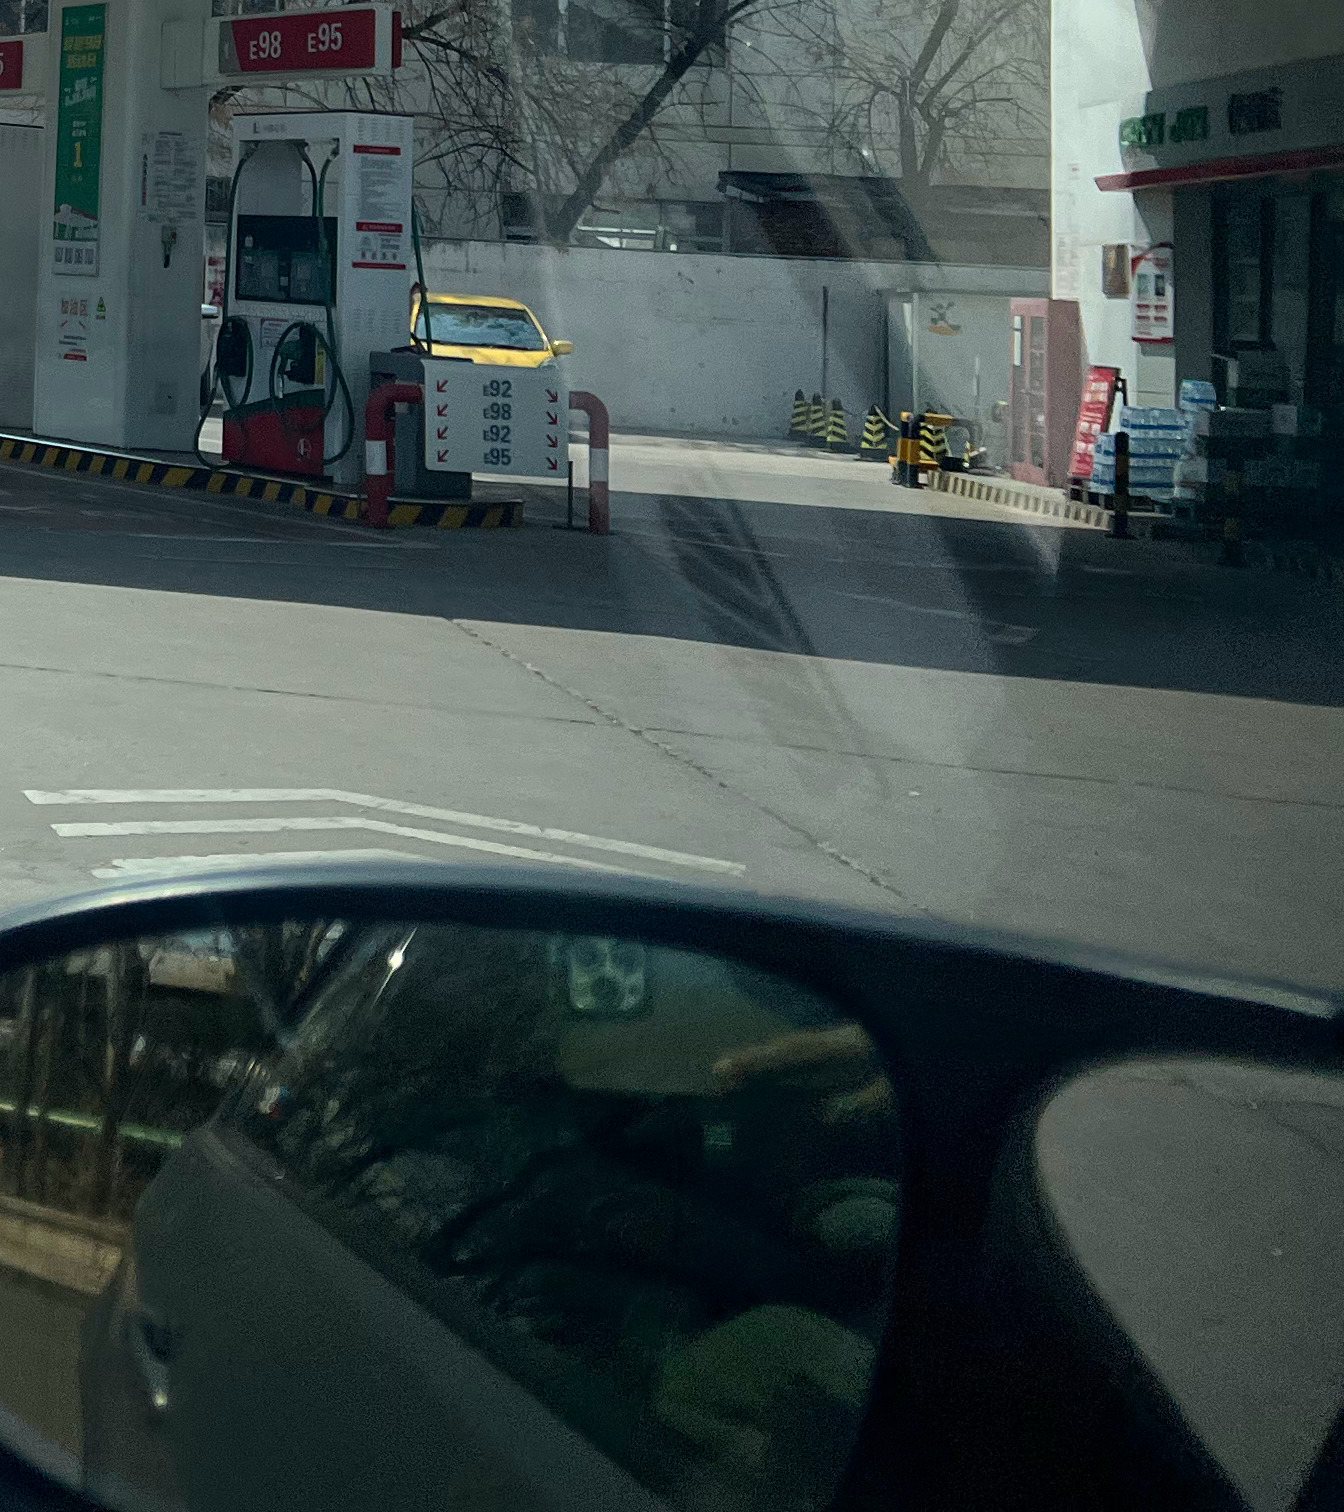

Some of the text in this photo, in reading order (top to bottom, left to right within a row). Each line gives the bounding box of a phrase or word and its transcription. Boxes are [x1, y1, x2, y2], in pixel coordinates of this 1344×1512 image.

[249, 23, 343, 60] E98 E95
[483, 380, 512, 398] E92
[483, 403, 512, 421] E98
[483, 425, 511, 443] E92
[483, 448, 512, 466] E95
